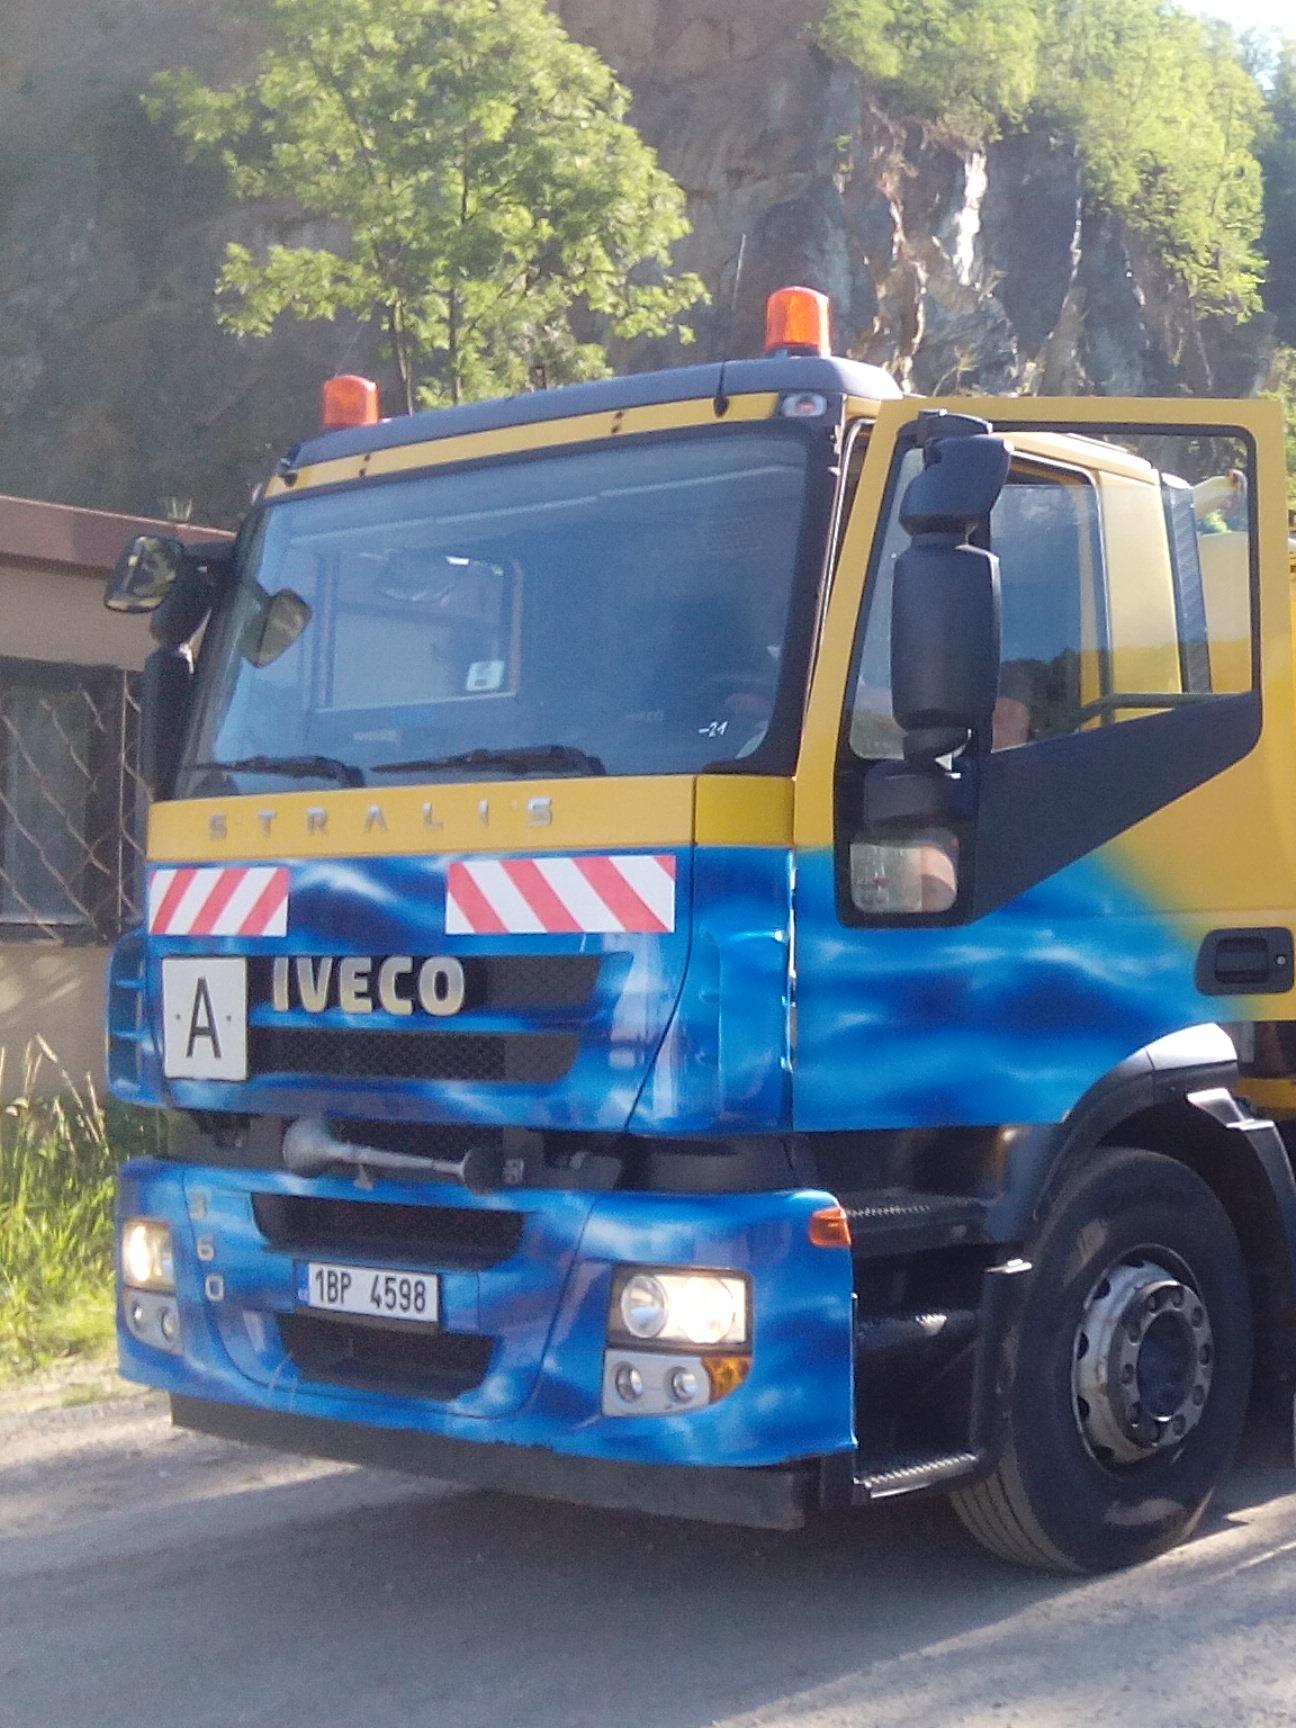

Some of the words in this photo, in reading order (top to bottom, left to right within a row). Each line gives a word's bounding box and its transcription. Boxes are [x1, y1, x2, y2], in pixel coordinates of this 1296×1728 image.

[209, 796, 553, 841] STRALIS
[272, 956, 466, 1017] IVECO
[185, 976, 222, 1059] A
[315, 1267, 352, 1305] 1BP
[369, 1274, 427, 1313] 4598
